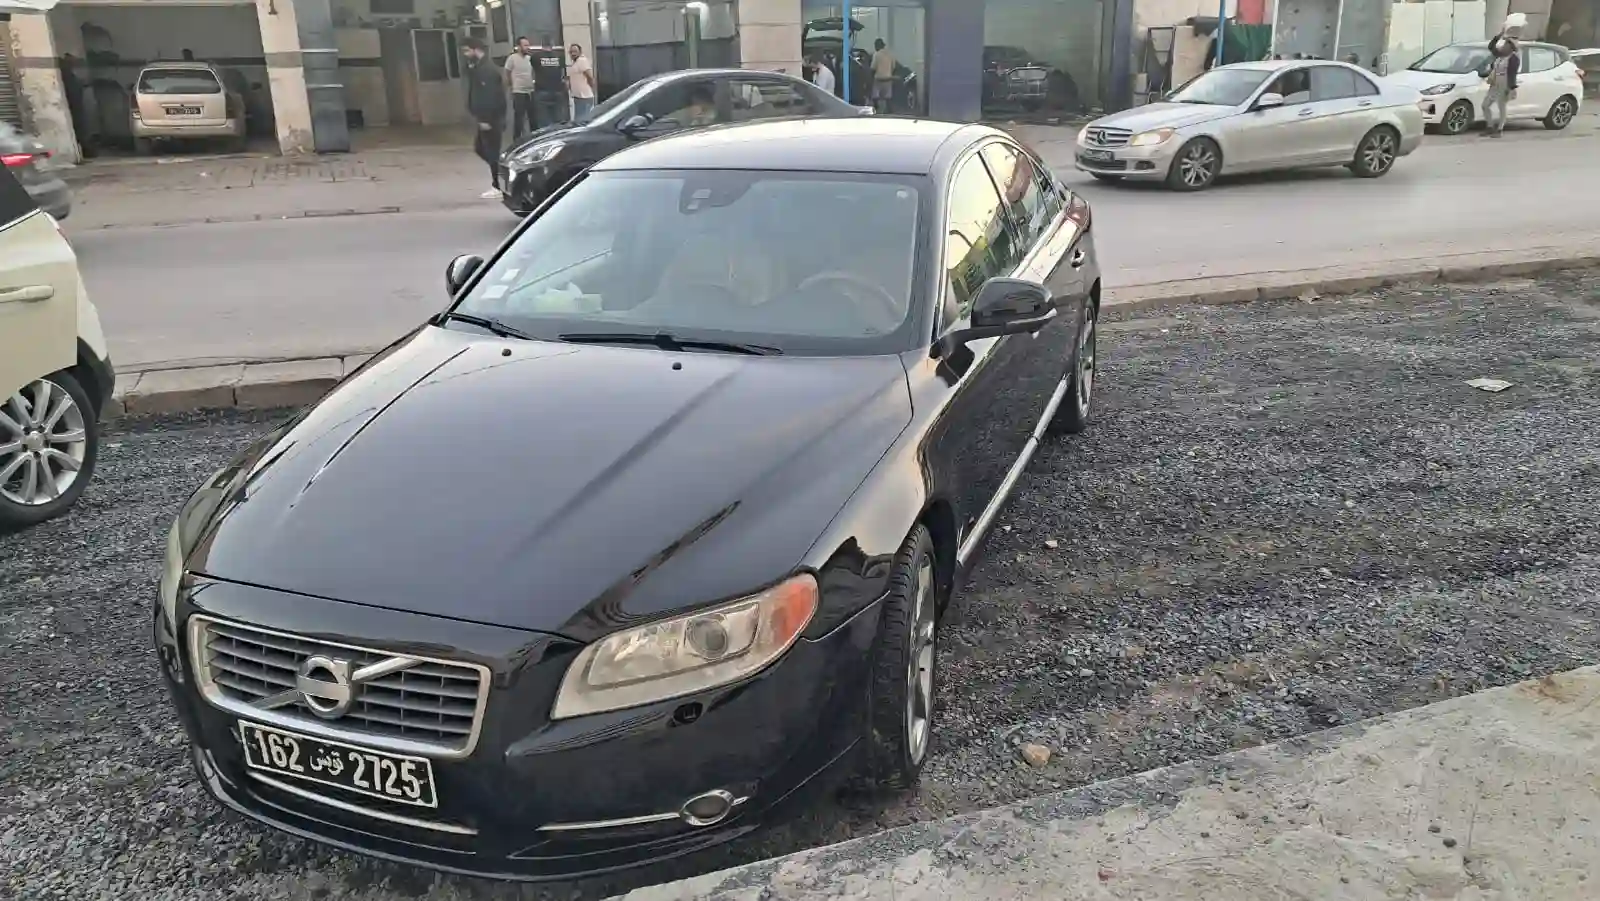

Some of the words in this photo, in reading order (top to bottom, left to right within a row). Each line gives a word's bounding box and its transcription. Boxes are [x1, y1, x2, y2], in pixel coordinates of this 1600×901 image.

[254, 729, 304, 773] 162
[309, 748, 344, 776] تونس
[348, 752, 421, 799] 2725
